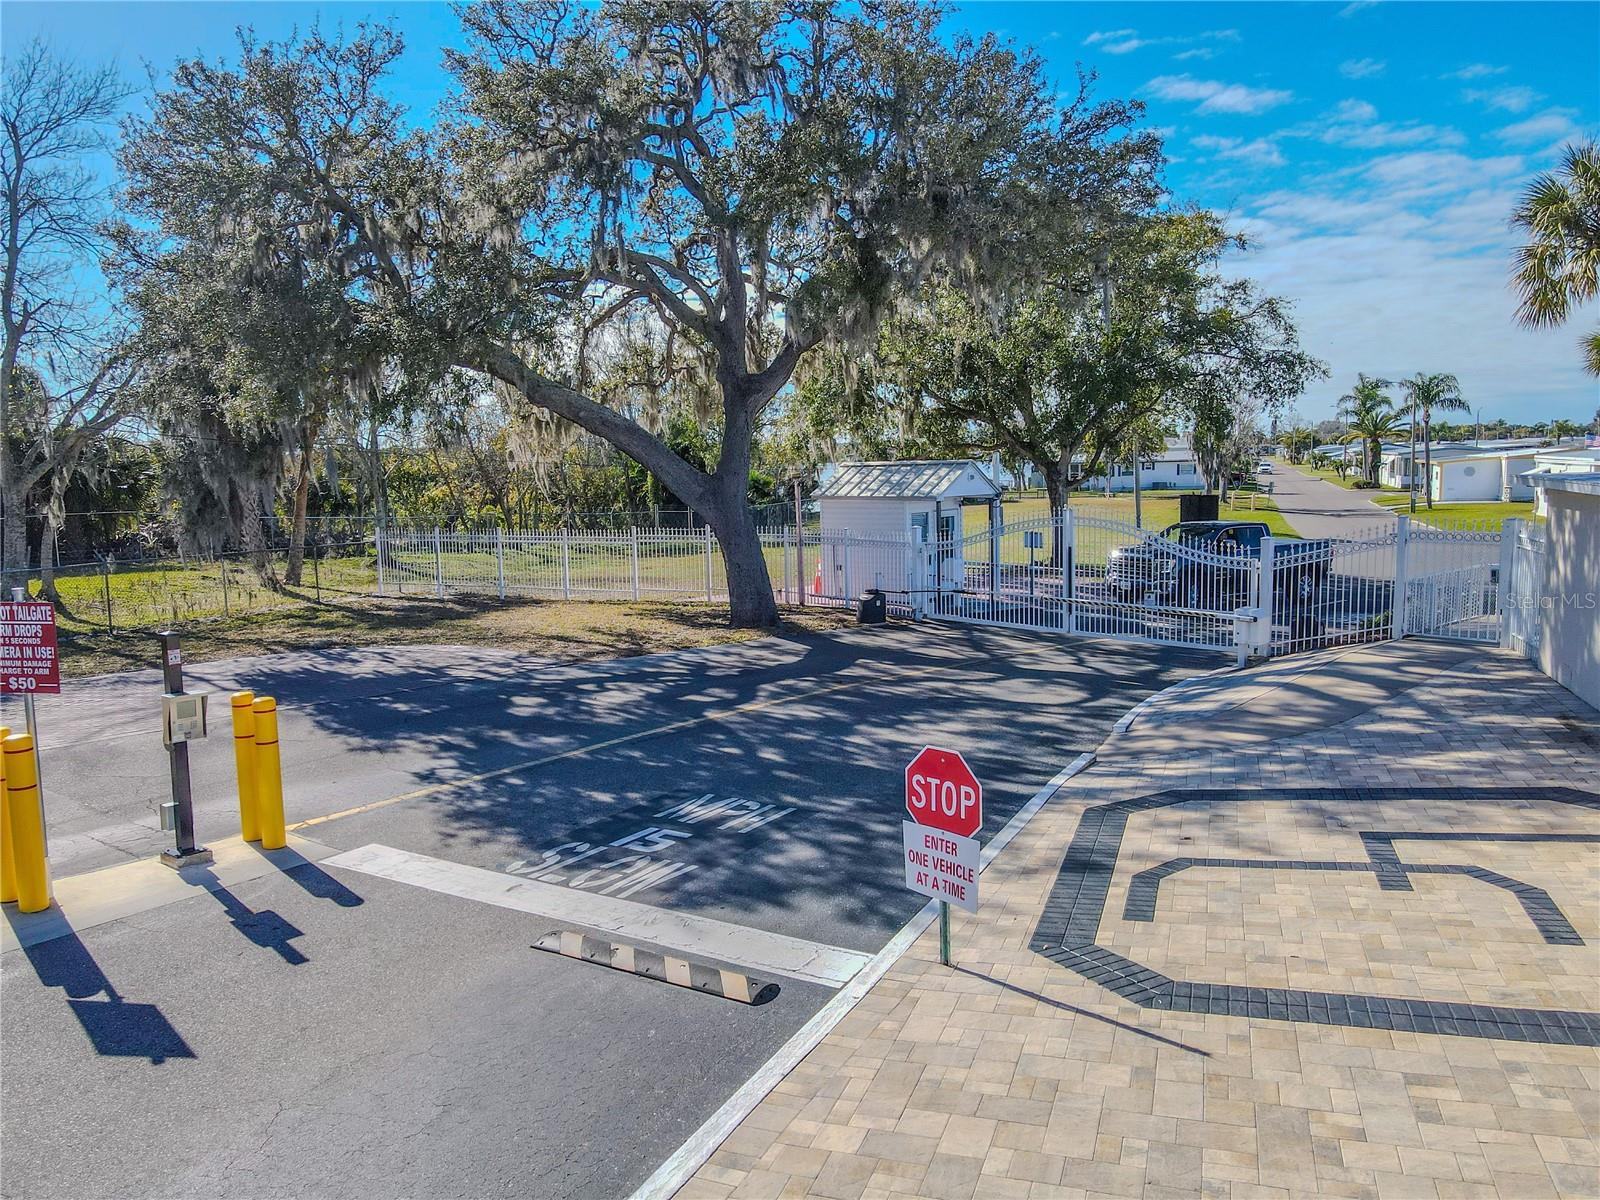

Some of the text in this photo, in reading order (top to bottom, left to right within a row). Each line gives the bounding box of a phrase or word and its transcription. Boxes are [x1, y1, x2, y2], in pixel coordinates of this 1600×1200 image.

[12, 605, 52, 621] TAILGATE
[11, 637, 41, 645] SECONDS
[14, 625, 43, 637] DROPS
[23, 647, 32, 659] IN
[35, 646, 55, 659] USE!
[23, 660, 52, 668] DAMAGE
[8, 677, 37, 690] $50
[911, 774, 976, 820] STOP
[653, 793, 797, 834] MPH
[609, 827, 694, 853] 15
[924, 834, 958, 857] ENTER
[505, 841, 699, 899] SLOW
[908, 849, 974, 883] ONE VEHICLE
[916, 871, 966, 901] AT A TIME
